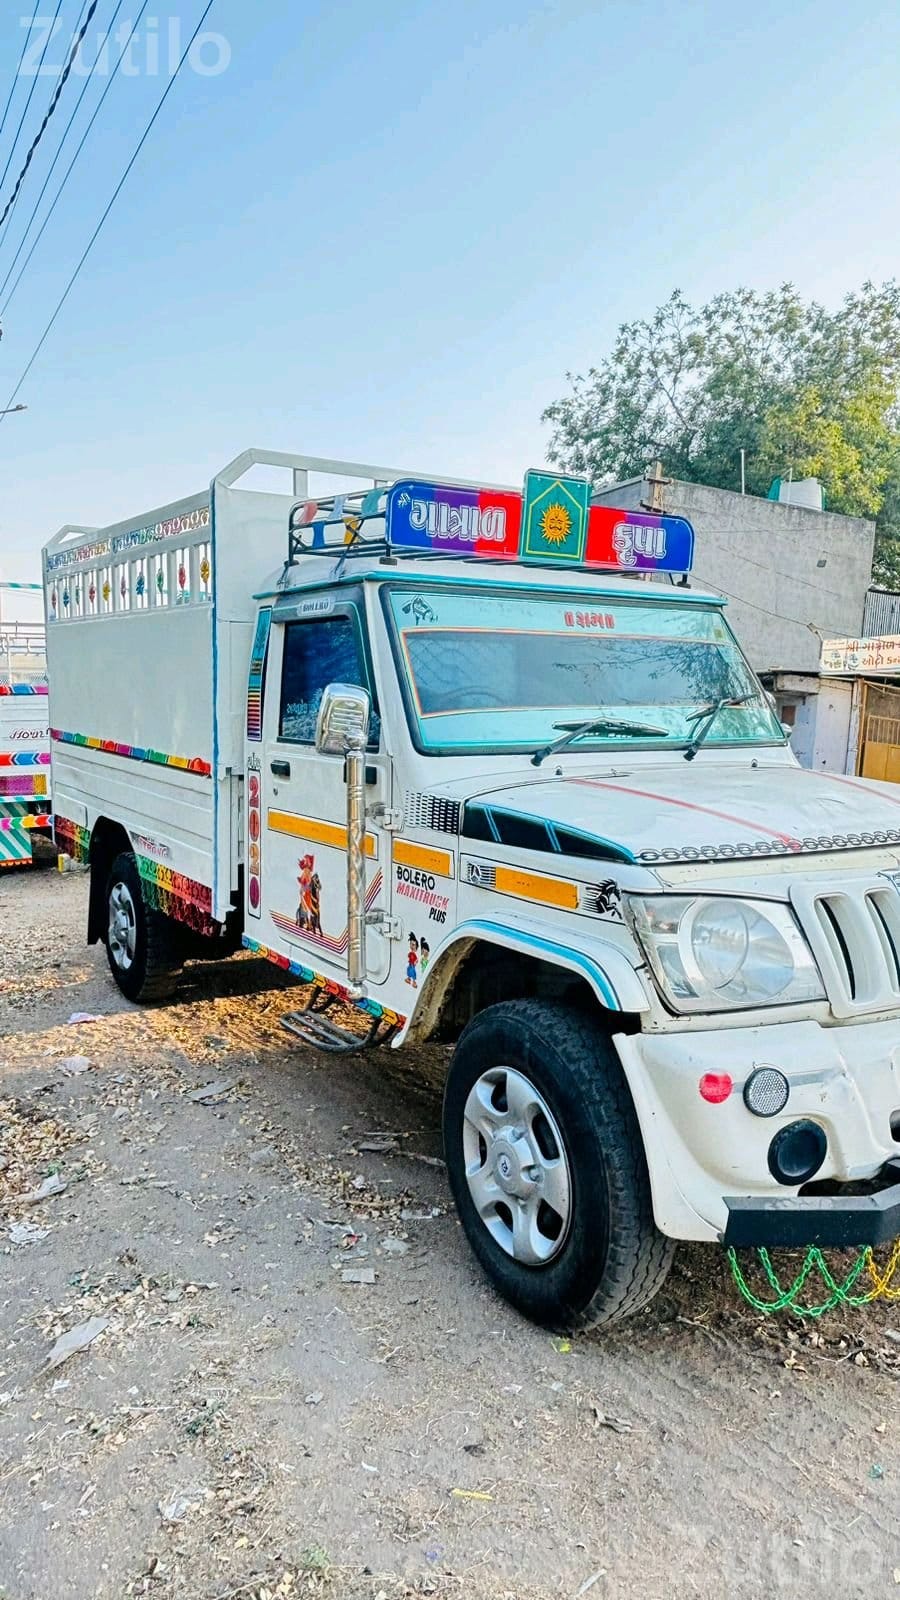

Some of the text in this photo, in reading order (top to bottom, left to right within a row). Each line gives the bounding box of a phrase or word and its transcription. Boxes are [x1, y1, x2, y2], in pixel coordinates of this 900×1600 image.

[396, 866, 436, 891] BOLERO
[396, 882, 450, 910] MAXITRUCK
[428, 907, 448, 924] PLUS
